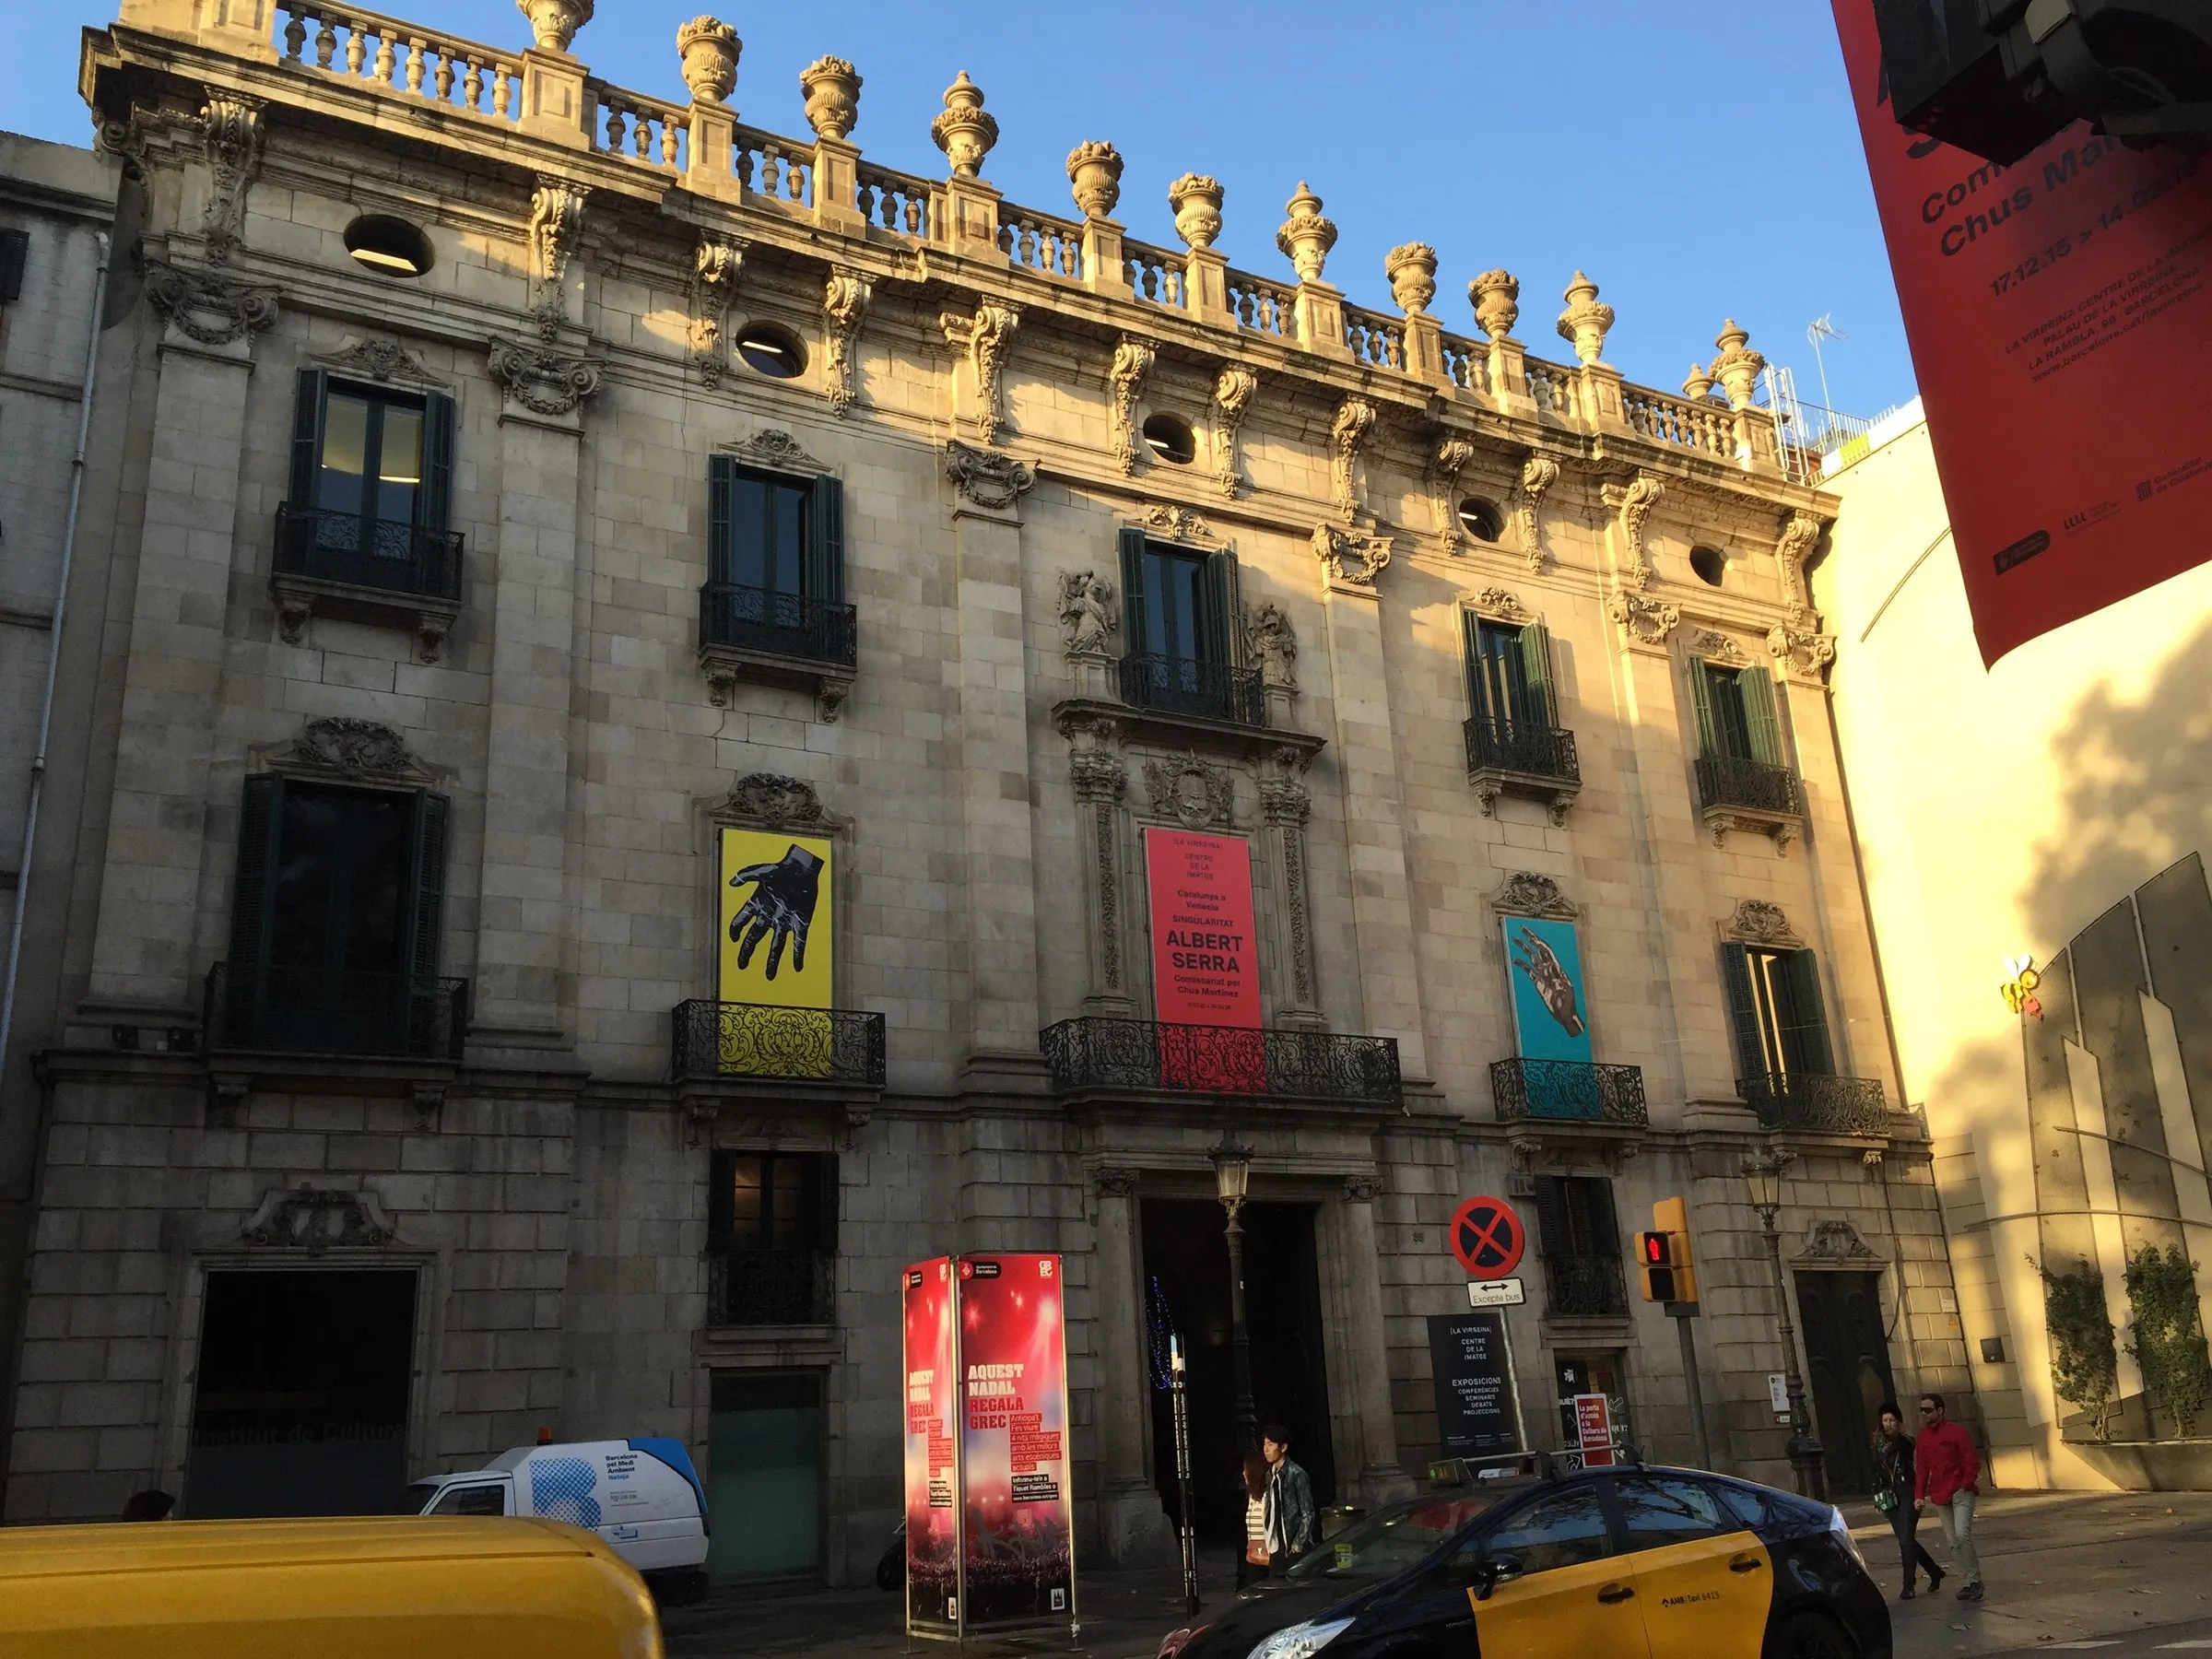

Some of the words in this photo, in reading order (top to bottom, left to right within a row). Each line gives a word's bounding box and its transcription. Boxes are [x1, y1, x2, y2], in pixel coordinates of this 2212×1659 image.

[1940, 185, 2033, 256] Chus
[1990, 235, 2072, 298] 17.12.15
[2006, 340, 2021, 354] LA
[2022, 308, 2076, 344] VIRREINA
[2078, 279, 2125, 312] CENTRE
[2127, 266, 2145, 283] DE
[2147, 257, 2163, 271] LA
[2042, 320, 2081, 347] PALAU
[2083, 309, 2100, 324] DE
[2102, 299, 2118, 314] LA
[2120, 265, 2177, 302] VIRREINA
[2028, 357, 2043, 371] LA
[2124, 266, 2201, 316] BARCELONA
[1177, 889, 1219, 901] Catalunya
[1172, 914, 1235, 927] SINGULARITAT
[1166, 929, 1243, 952] ALBERT
[1171, 951, 1241, 973] SERRA
[1173, 974, 1225, 986] Comissariat
[1177, 986, 1200, 995] Chus
[1473, 1294, 1503, 1304] Excepte
[1505, 1293, 1521, 1301] bus
[968, 1363, 1024, 1381] AQUEST
[969, 1381, 1016, 1396] NADAL
[1452, 1376, 1501, 1387] EXPOSICIONS
[970, 1397, 1024, 1413] REGALA
[1465, 1394, 1496, 1402] SEMINARIS
[1586, 1405, 1599, 1413] porta
[910, 1420, 926, 1434] GREC
[970, 1415, 1006, 1430] GREC
[1013, 1485, 1029, 1493] Tiquet
[1688, 1593, 1701, 1603] Taxi
